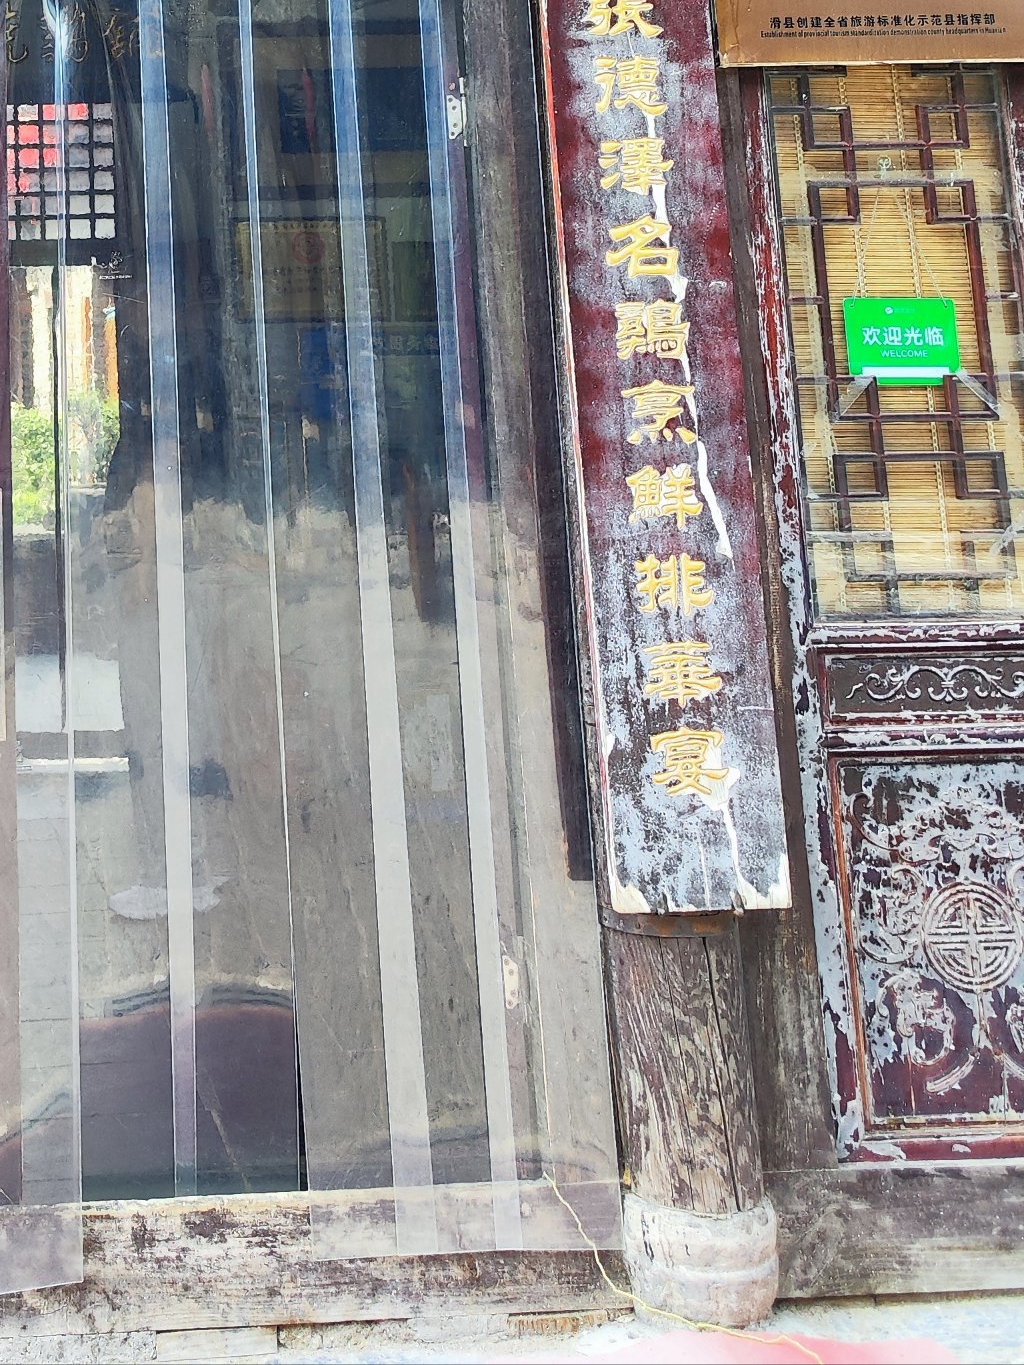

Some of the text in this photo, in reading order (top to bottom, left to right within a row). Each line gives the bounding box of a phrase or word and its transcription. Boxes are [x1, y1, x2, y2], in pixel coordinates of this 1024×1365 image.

[769, 12, 996, 29] 滑县创建全省旅游标准化示范县指挥部
[760, 30, 796, 38] Establishment
[861, 325, 945, 347] 欢迎光临
[880, 349, 929, 359] WELCOME
